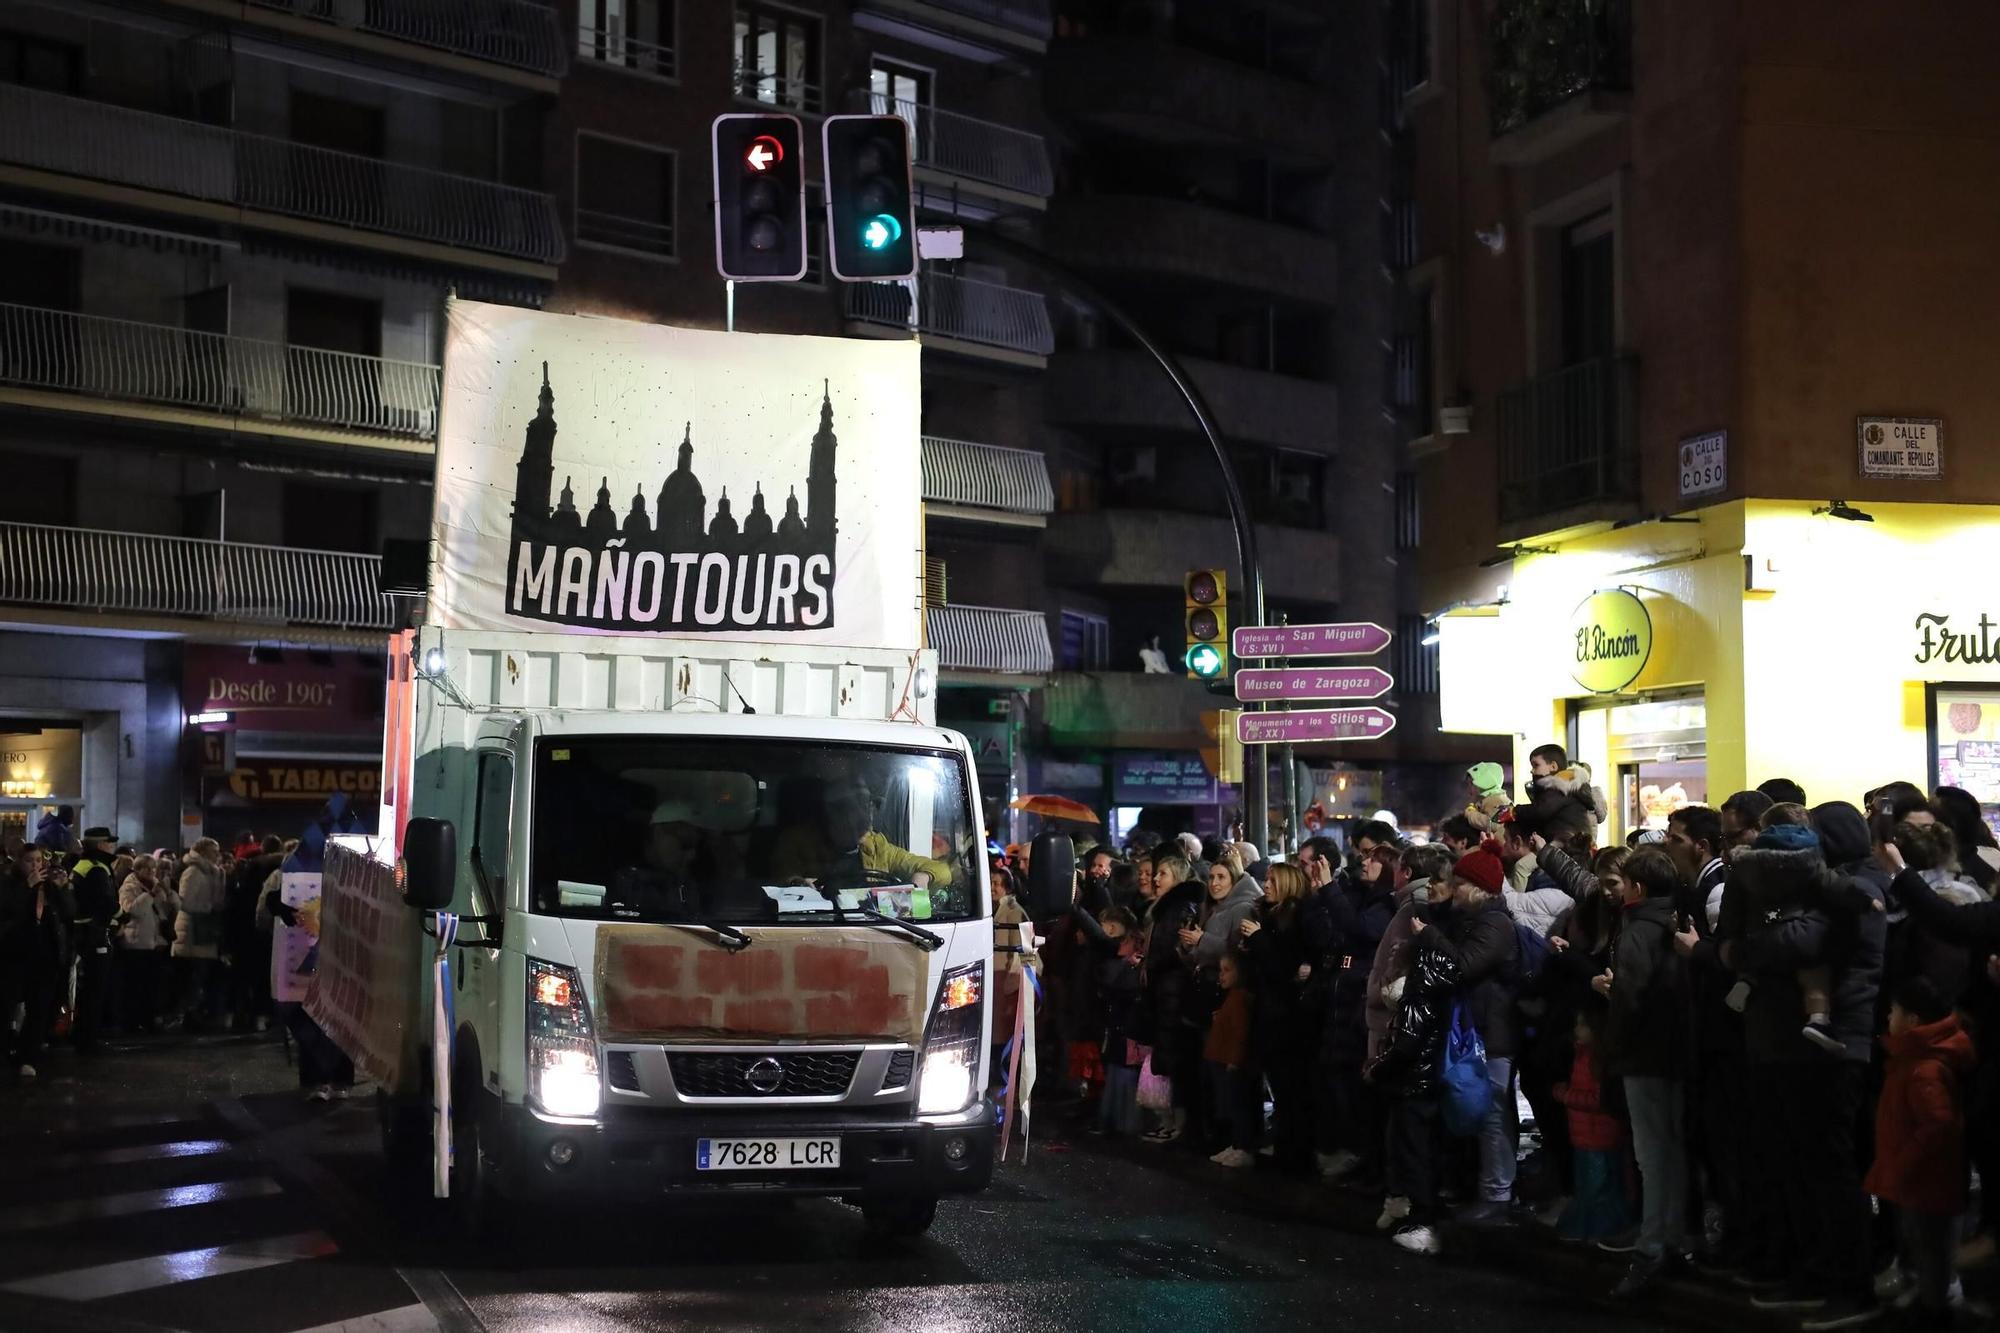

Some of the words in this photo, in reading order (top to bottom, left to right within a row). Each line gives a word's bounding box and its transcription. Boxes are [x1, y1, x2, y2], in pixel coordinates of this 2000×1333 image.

[1894, 427, 1926, 439] CALLE
[1695, 438, 1720, 456] CALLE
[1905, 440, 1920, 449] DEL
[1868, 450, 1904, 465] COMANDANTE
[1683, 465, 1722, 489] COSO
[513, 538, 830, 625] MAÑOTOURS
[1242, 634, 1269, 644] Iglesia
[1275, 633, 1286, 642] de
[1293, 629, 1315, 641] San
[1325, 628, 1366, 642] Miguel
[1575, 627, 1590, 662] El
[1592, 624, 1640, 661] Rincón
[208, 677, 276, 703] Desde
[286, 682, 336, 705] 1907
[1244, 679, 1283, 690] Museo
[1292, 678, 1306, 689] de
[1315, 677, 1370, 691] Zaragoza
[1309, 718, 1322, 726] los
[1330, 713, 1365, 725] Sitios
[269, 769, 381, 792] TABACO
[718, 1142, 777, 1165] 7628
[790, 1141, 834, 1164] LCR
